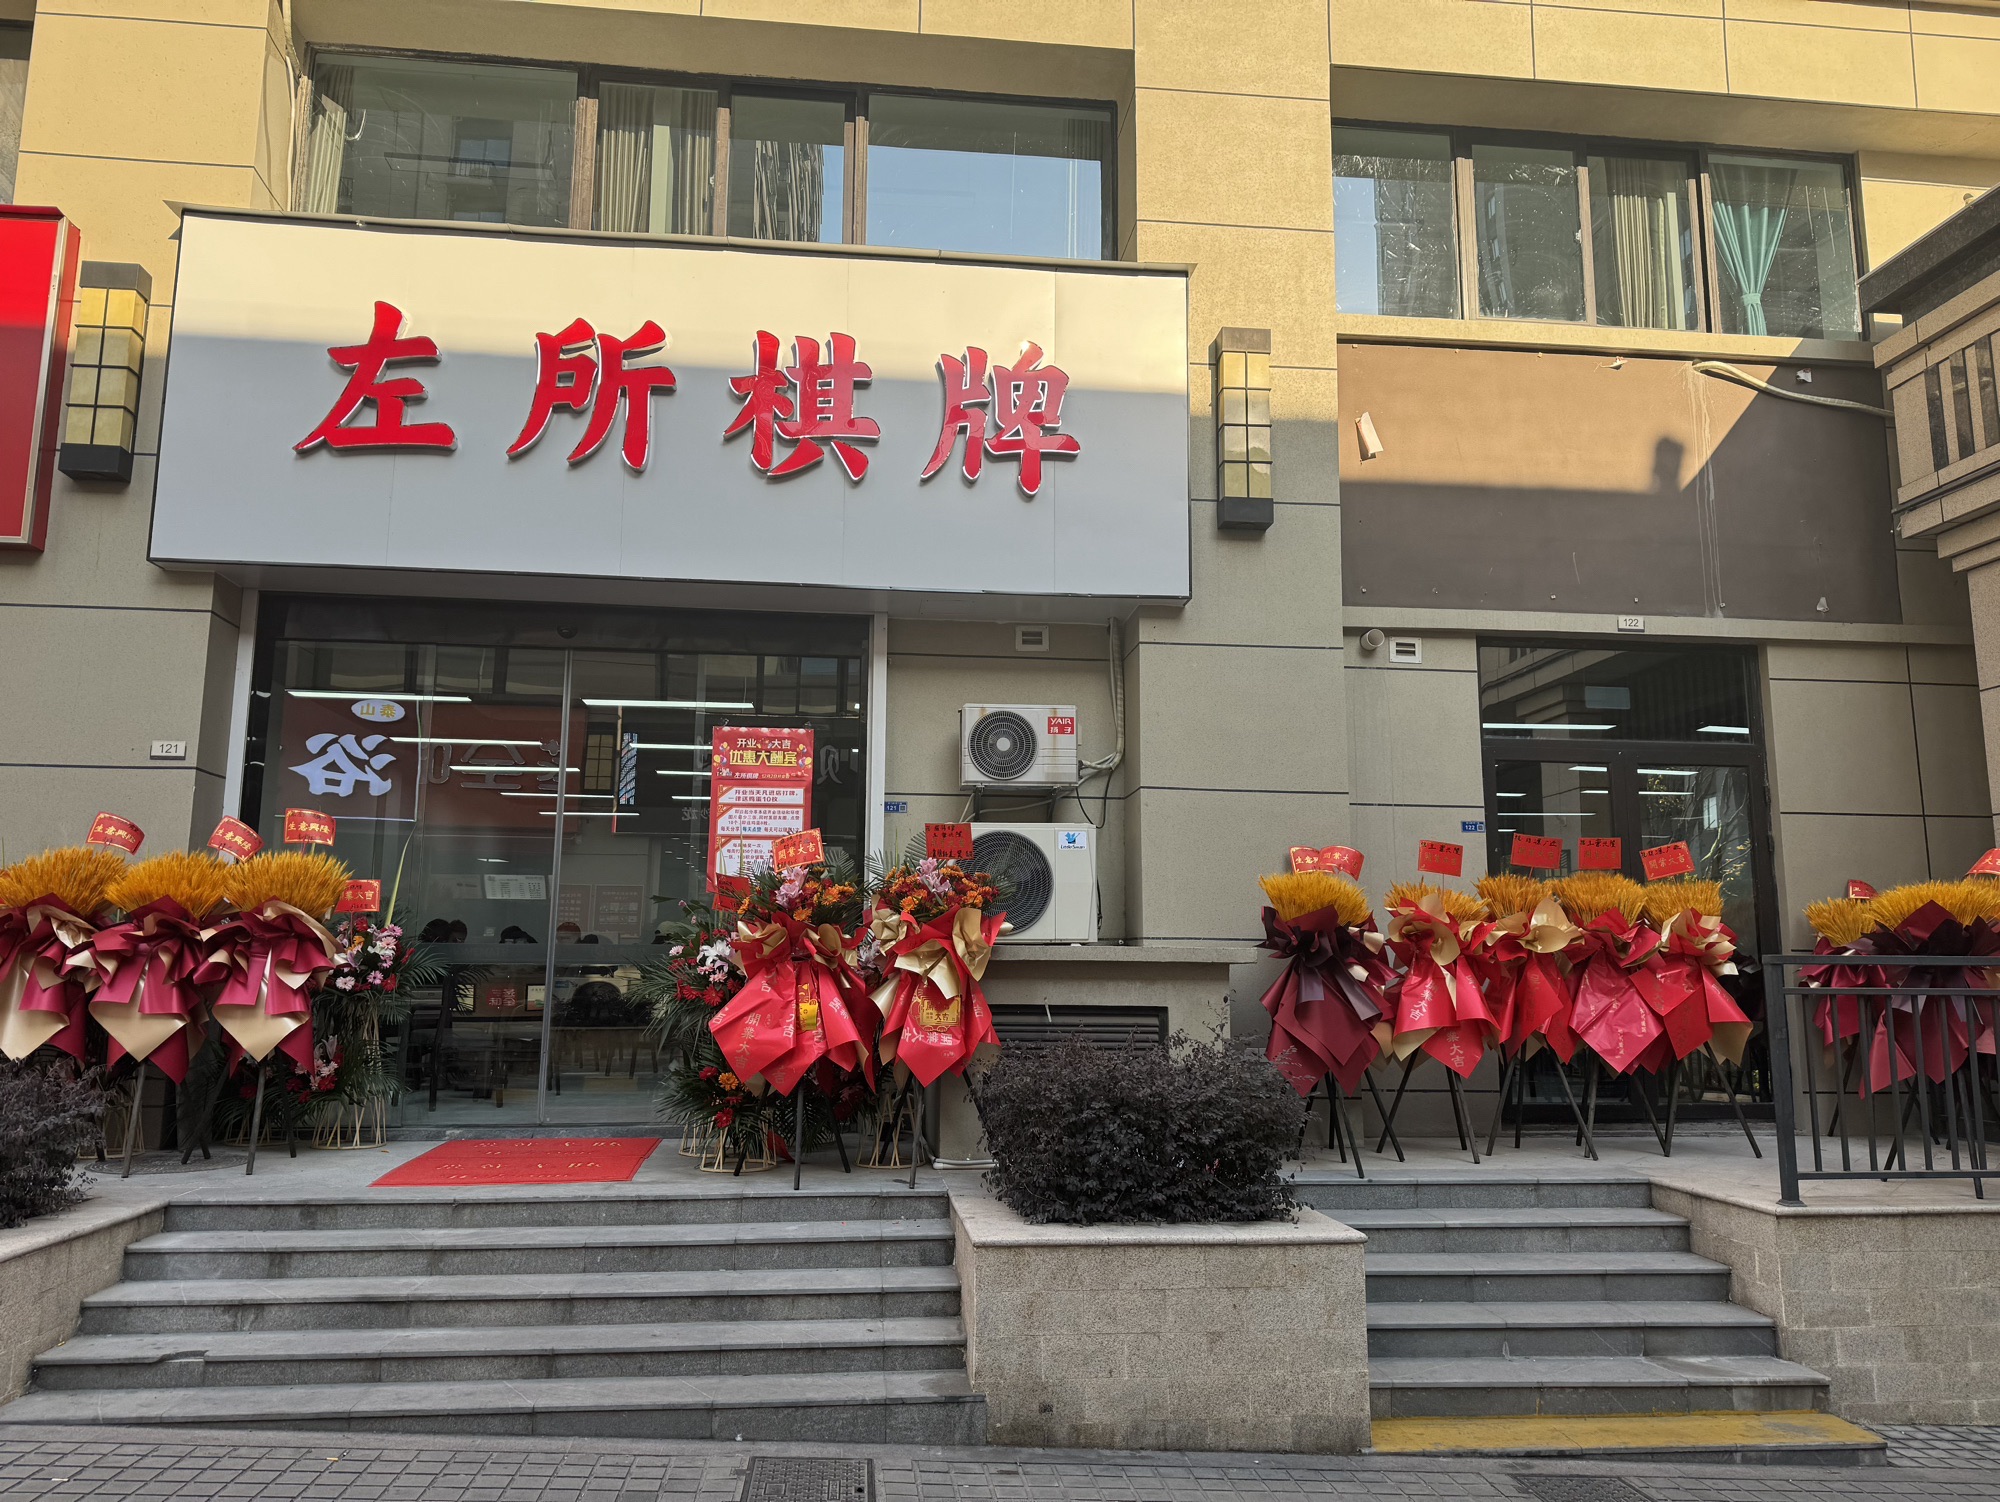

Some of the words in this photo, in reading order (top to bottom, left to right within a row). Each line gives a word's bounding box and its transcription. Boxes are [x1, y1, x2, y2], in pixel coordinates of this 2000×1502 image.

[292, 300, 1081, 497] 左所棋牌
[1624, 618, 1639, 628] 122
[1050, 717, 1072, 725] YAIR
[159, 743, 178, 754] 121
[736, 738, 757, 748] 开业
[771, 739, 791, 749] 大吉
[729, 749, 798, 767] 优惠大酬宾
[777, 841, 817, 860] 開業大吉
